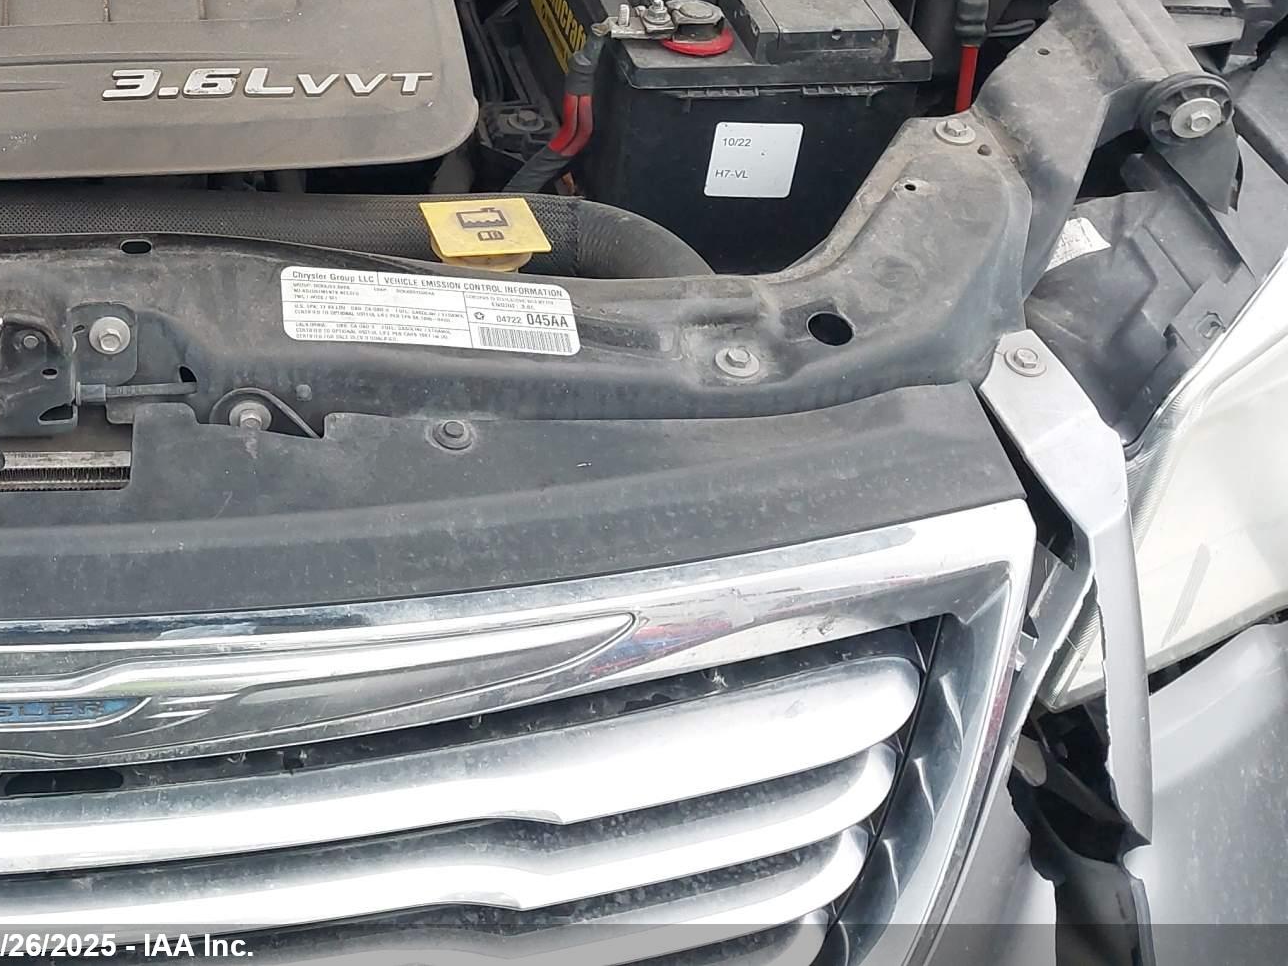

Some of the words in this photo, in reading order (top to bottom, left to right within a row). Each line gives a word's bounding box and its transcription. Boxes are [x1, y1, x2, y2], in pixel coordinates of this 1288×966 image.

[722, 138, 752, 147] 10/22
[714, 170, 749, 178] H7-VL
[292, 270, 328, 282] Chrysler
[330, 272, 356, 282] Group
[358, 274, 374, 283] LLC
[384, 276, 418, 287] VEHICLE
[421, 280, 461, 290] EMISSION
[463, 282, 501, 292] CONTROL
[504, 286, 563, 297] INFORMATION
[496, 315, 522, 324] 04722
[526, 314, 570, 328] 045AA
